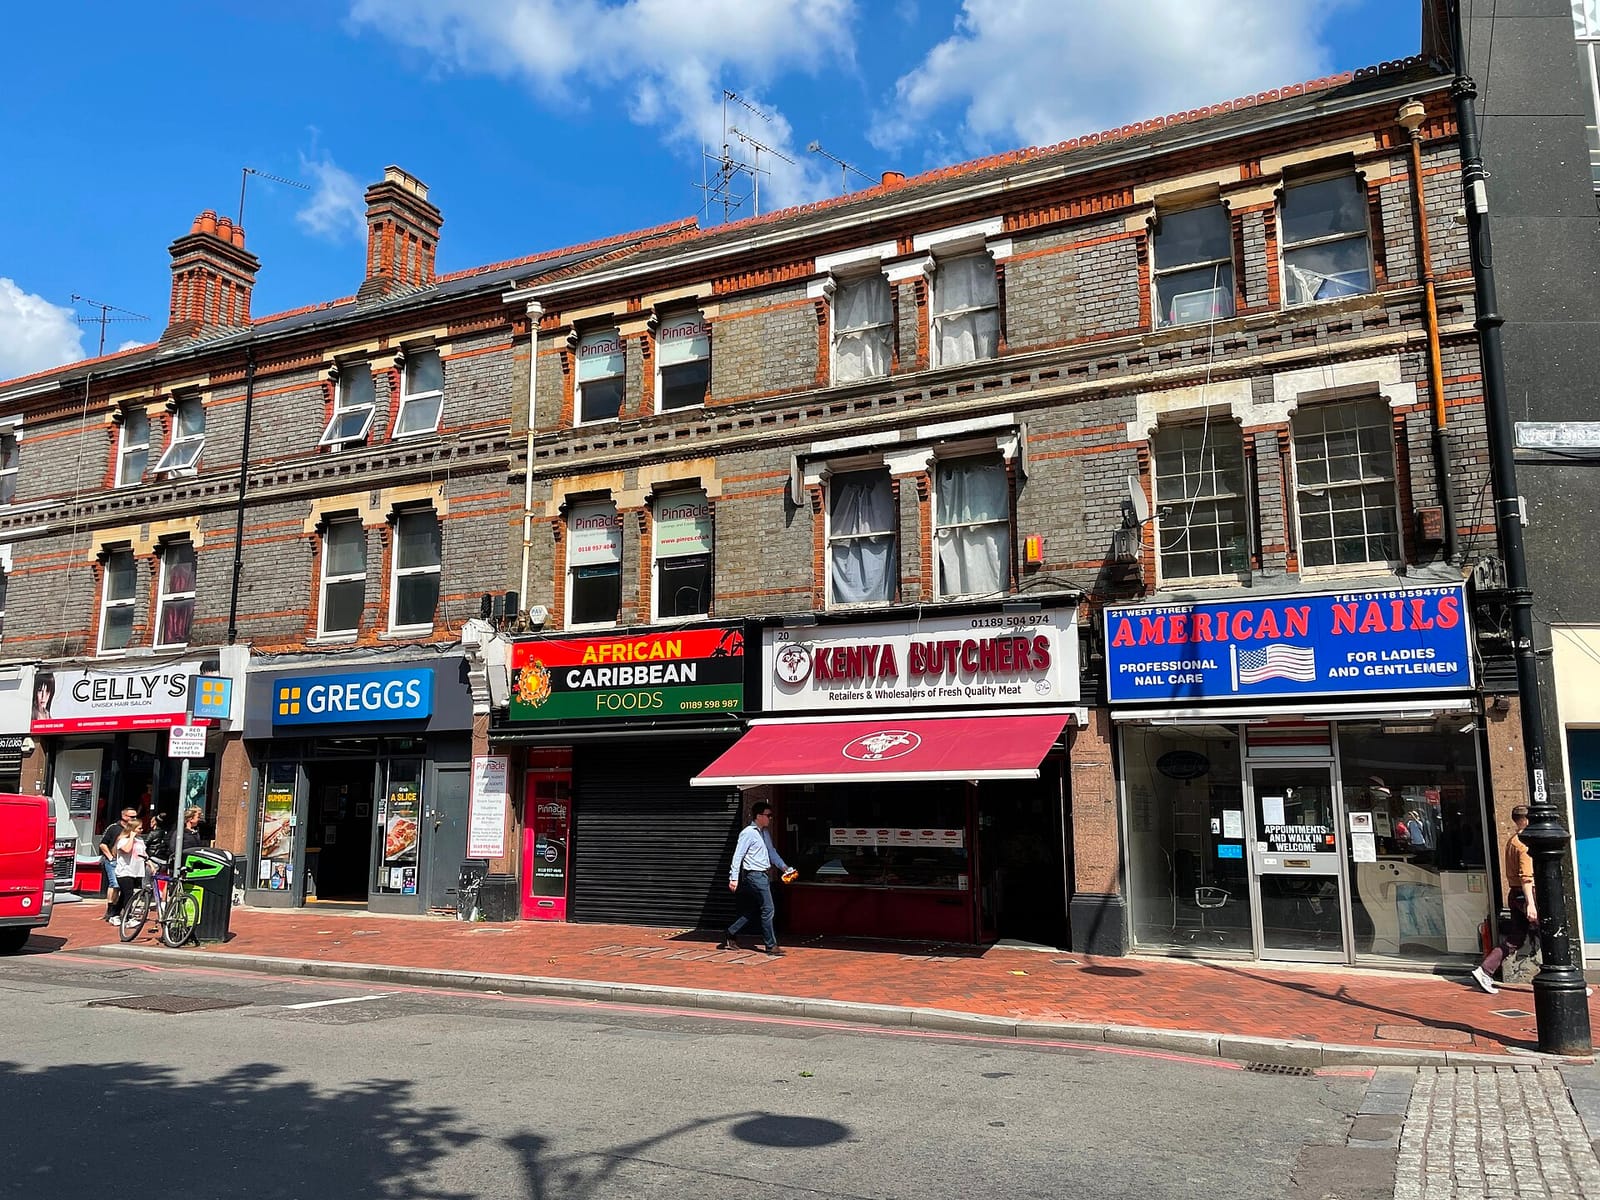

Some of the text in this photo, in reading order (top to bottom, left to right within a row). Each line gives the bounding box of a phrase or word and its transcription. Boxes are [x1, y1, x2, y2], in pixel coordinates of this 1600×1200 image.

[661, 503, 708, 520] Pinnacle
[1126, 608, 1152, 617] WEST
[1155, 606, 1194, 615] STREET
[971, 615, 1050, 628] 01189 504 974
[1112, 596, 1460, 647] AMERICAN NAILS
[778, 632, 789, 640] 20
[582, 639, 682, 664] AFRICAN
[815, 635, 1051, 681] KENYA BUTCHERS
[1347, 648, 1436, 663] FOR LADIES
[1119, 660, 1218, 673] PROFESSIONAL
[1328, 662, 1458, 678] AND GENTLEMEN
[566, 663, 697, 689] CARIBBEAN
[1134, 673, 1203, 686] NAIL CARE
[72, 673, 186, 702] CELLY'S
[829, 690, 865, 701] Retailers
[866, 690, 873, 699] &
[875, 688, 926, 699] Wholesalers
[927, 687, 937, 697] of
[938, 686, 963, 697] Fresh
[964, 685, 996, 697] Quality
[999, 685, 1022, 695] Meat
[307, 679, 421, 714] GREGGS
[597, 691, 663, 711] FOODS
[680, 699, 738, 710] 01189 598 987
[476, 761, 505, 770] Pinnacle
[390, 792, 417, 801] A SLICE
[1265, 825, 1327, 834] APPOINTMENTS
[1269, 834, 1323, 843] AND WALK IN
[1275, 843, 1317, 852] WELCOME
